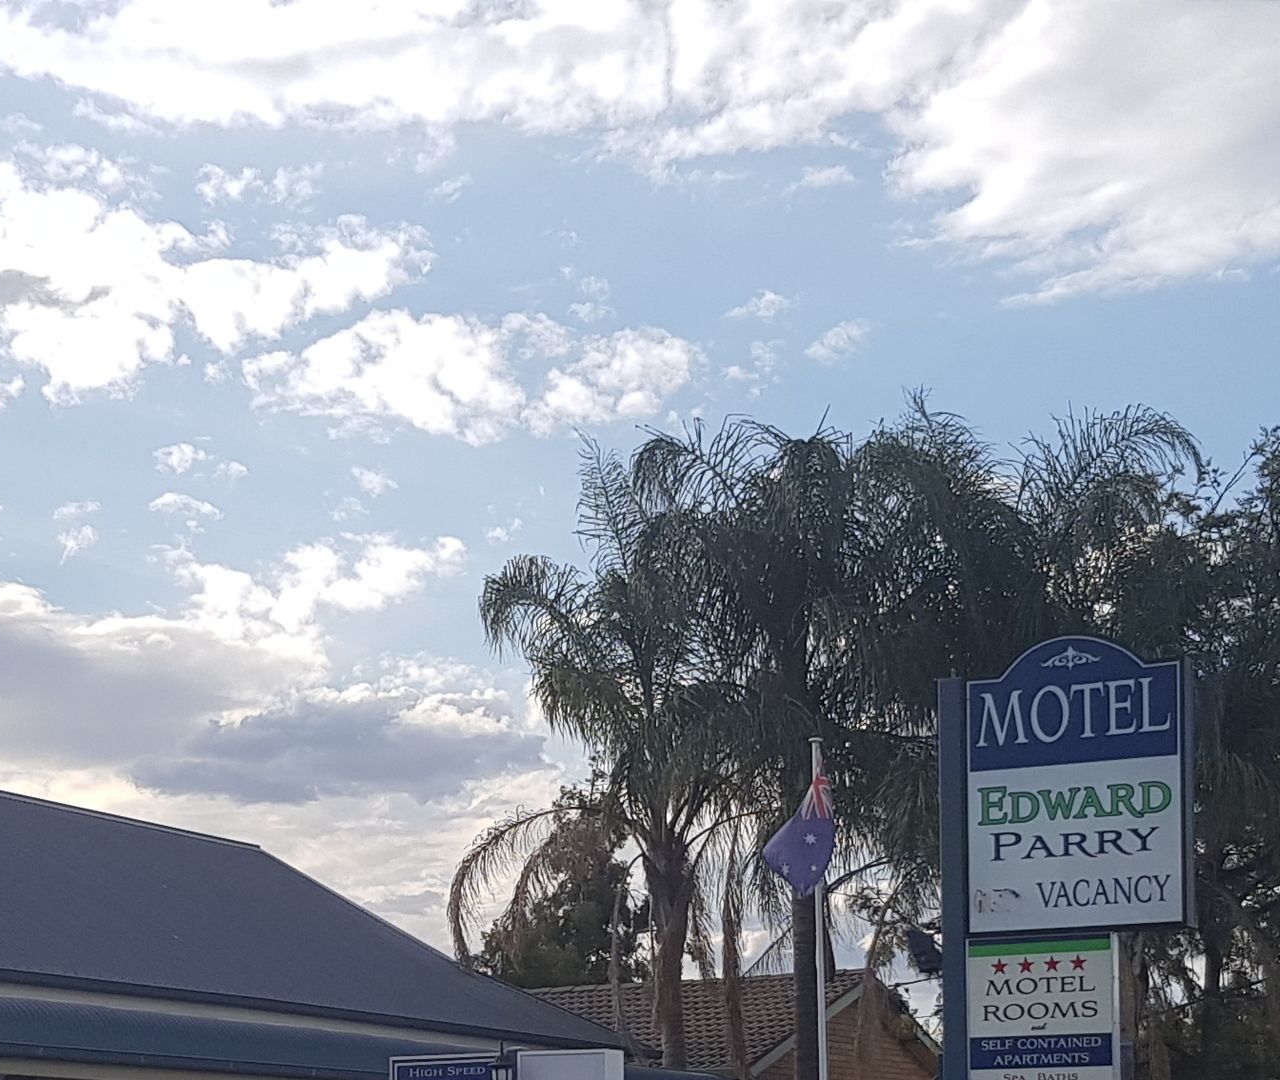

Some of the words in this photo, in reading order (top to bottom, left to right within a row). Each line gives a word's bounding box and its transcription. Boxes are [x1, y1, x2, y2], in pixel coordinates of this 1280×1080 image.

[975, 677, 1171, 748] MOTEL
[977, 781, 1173, 827] EDWARD
[990, 826, 1160, 862] PARRY
[1036, 874, 1171, 908] VACANCY
[985, 975, 1097, 997] MOTEL
[981, 1000, 1098, 1022] ROOMS
[981, 1040, 1013, 1051] SELF
[1018, 1036, 1102, 1050] CONTAINED
[993, 1052, 1090, 1066] APARTMENTS
[409, 1067, 443, 1078] HIGH
[447, 1066, 486, 1076] SPEED
